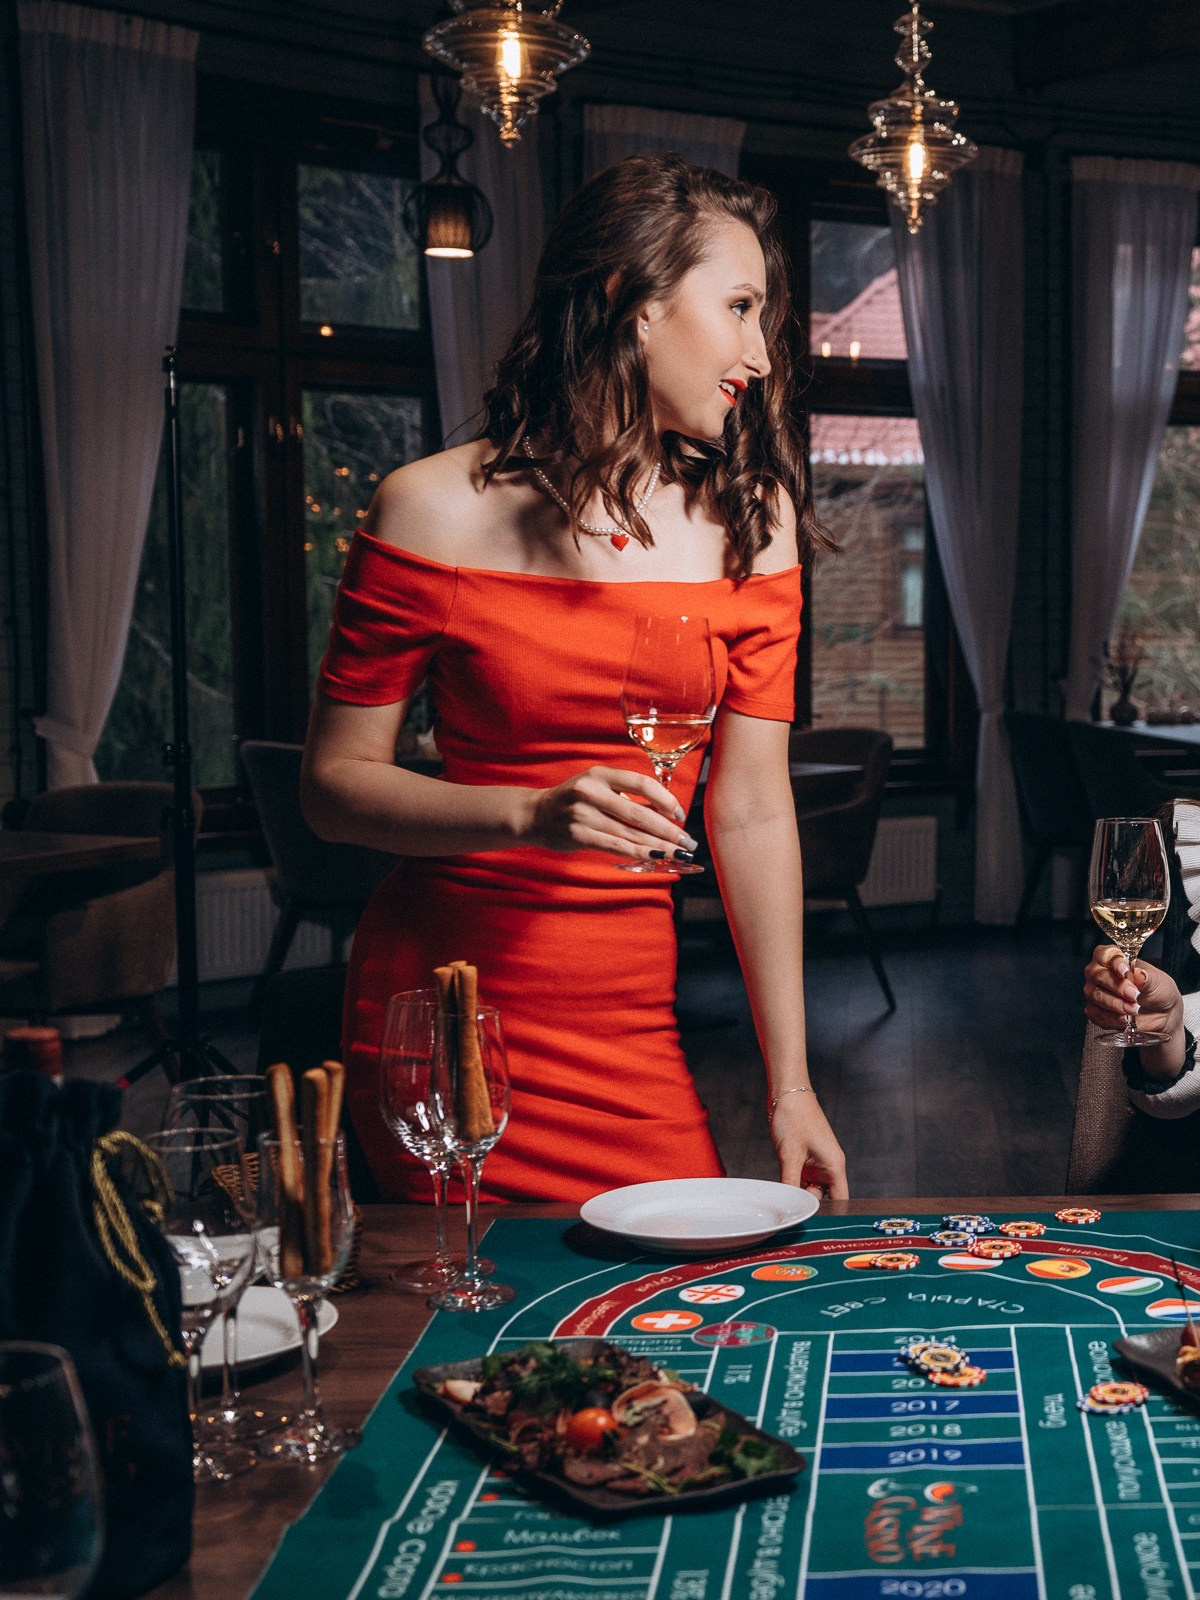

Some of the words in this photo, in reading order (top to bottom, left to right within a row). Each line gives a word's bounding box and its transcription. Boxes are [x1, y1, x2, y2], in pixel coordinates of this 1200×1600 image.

[818, 1296, 887, 1319] СВЕТ
[907, 1291, 1025, 1314] СТАРЫЙ
[893, 1334, 957, 1345] 2014
[890, 1399, 960, 1414] 2017
[889, 1423, 962, 1437] 2018
[888, 1448, 962, 1465] 2019
[880, 1577, 967, 1598] 2020
